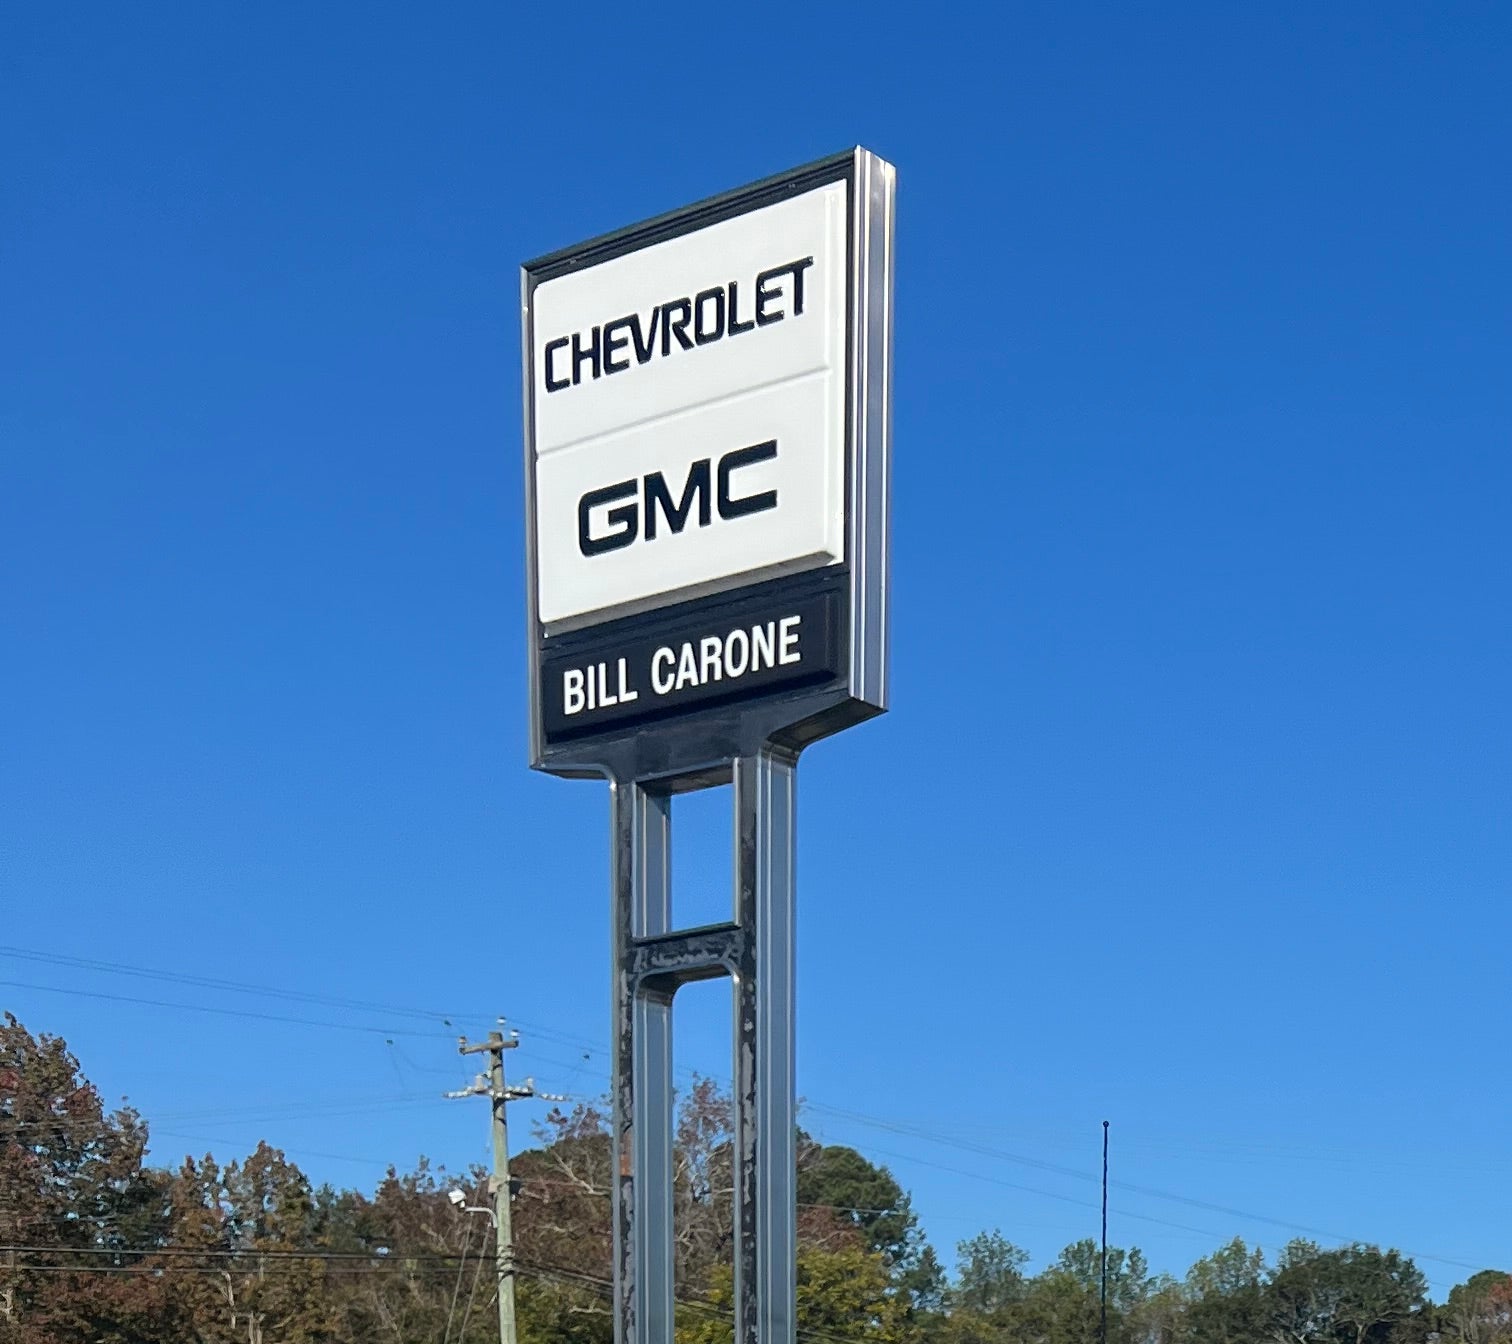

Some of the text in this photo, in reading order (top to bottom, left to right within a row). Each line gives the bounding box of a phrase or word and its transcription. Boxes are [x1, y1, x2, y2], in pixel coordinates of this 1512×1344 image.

[544, 256, 815, 394] CHEVROLET
[578, 438, 778, 558] GMC
[563, 615, 802, 716] BILL CARONE
